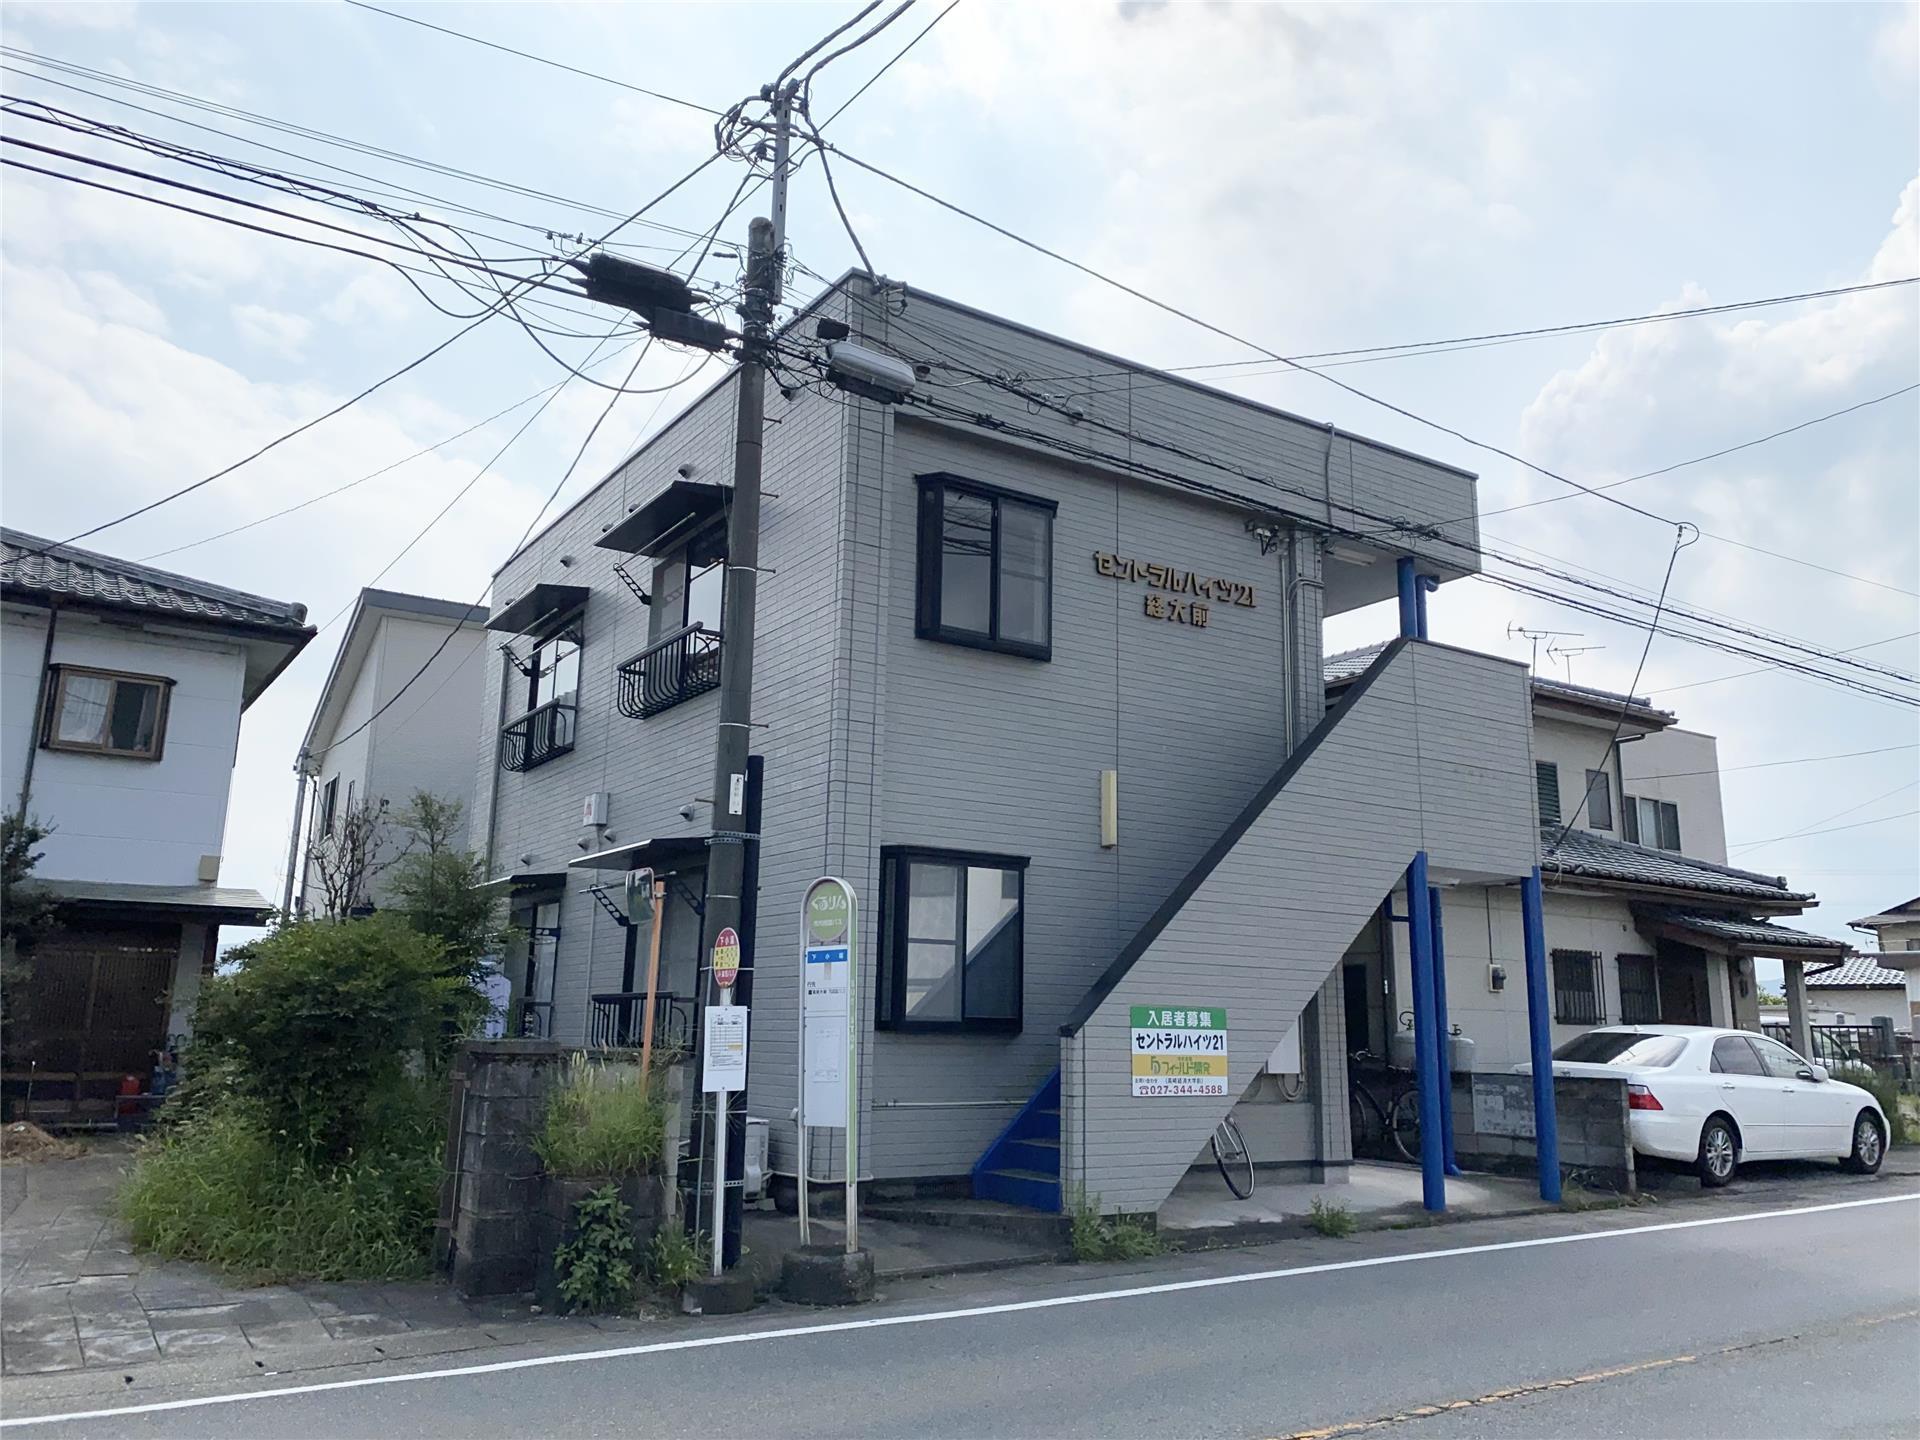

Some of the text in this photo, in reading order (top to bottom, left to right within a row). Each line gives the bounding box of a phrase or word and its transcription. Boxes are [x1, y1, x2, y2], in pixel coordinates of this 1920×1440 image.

[1094, 550, 1256, 607] セントラルハイツ21
[1145, 593, 1209, 627] 経大前
[1147, 1011, 1212, 1027] 入居者募集
[1136, 1033, 1224, 1050] セントラルハイツ21
[1150, 1085, 1223, 1095] 027-344-4588
